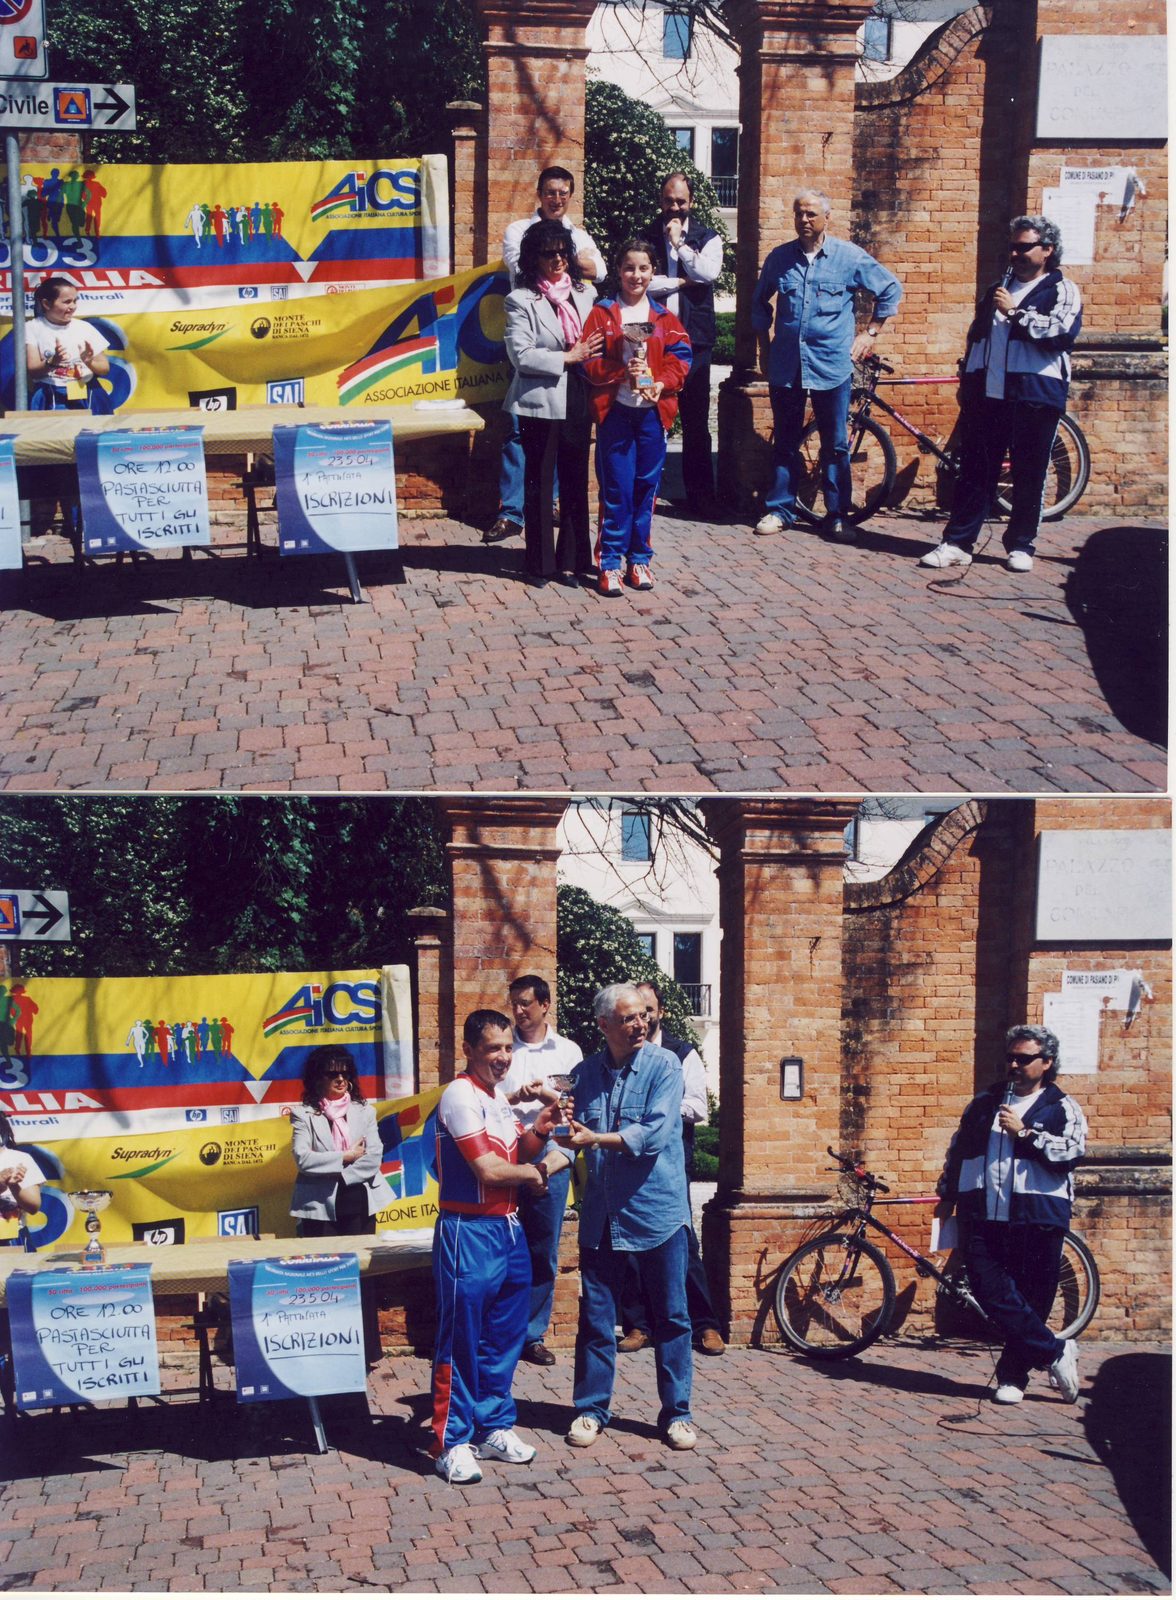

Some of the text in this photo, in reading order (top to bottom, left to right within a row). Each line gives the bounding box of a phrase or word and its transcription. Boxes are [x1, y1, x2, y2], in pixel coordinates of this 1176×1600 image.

[274, 314, 304, 322] MONTE
[170, 321, 226, 334] Supradyn
[364, 372, 504, 403] ASSOCIAZIONE ITALIANA
[114, 462, 148, 475] ORE
[101, 480, 202, 496] PASTASCIUTTA
[132, 496, 171, 508] PER
[304, 488, 393, 510] ISCRIZIONI
[116, 509, 197, 525] TUTTI GLI
[138, 523, 200, 539] ISCRITTI
[1067, 975, 1083, 984] COMUNE
[225, 1138, 258, 1146] MONTE
[242, 1144, 276, 1152] PASCHI
[111, 1147, 172, 1162] Supradyn
[235, 1151, 264, 1159] SIENA
[51, 1303, 143, 1320] ORE 12.00
[36, 1324, 150, 1344] PASTASCIUTTA
[264, 1326, 360, 1353] ISCRIZIONI
[71, 1342, 116, 1357] PER
[52, 1356, 145, 1375] TUTTI GLI
[77, 1371, 149, 1391] ISCRITTI
